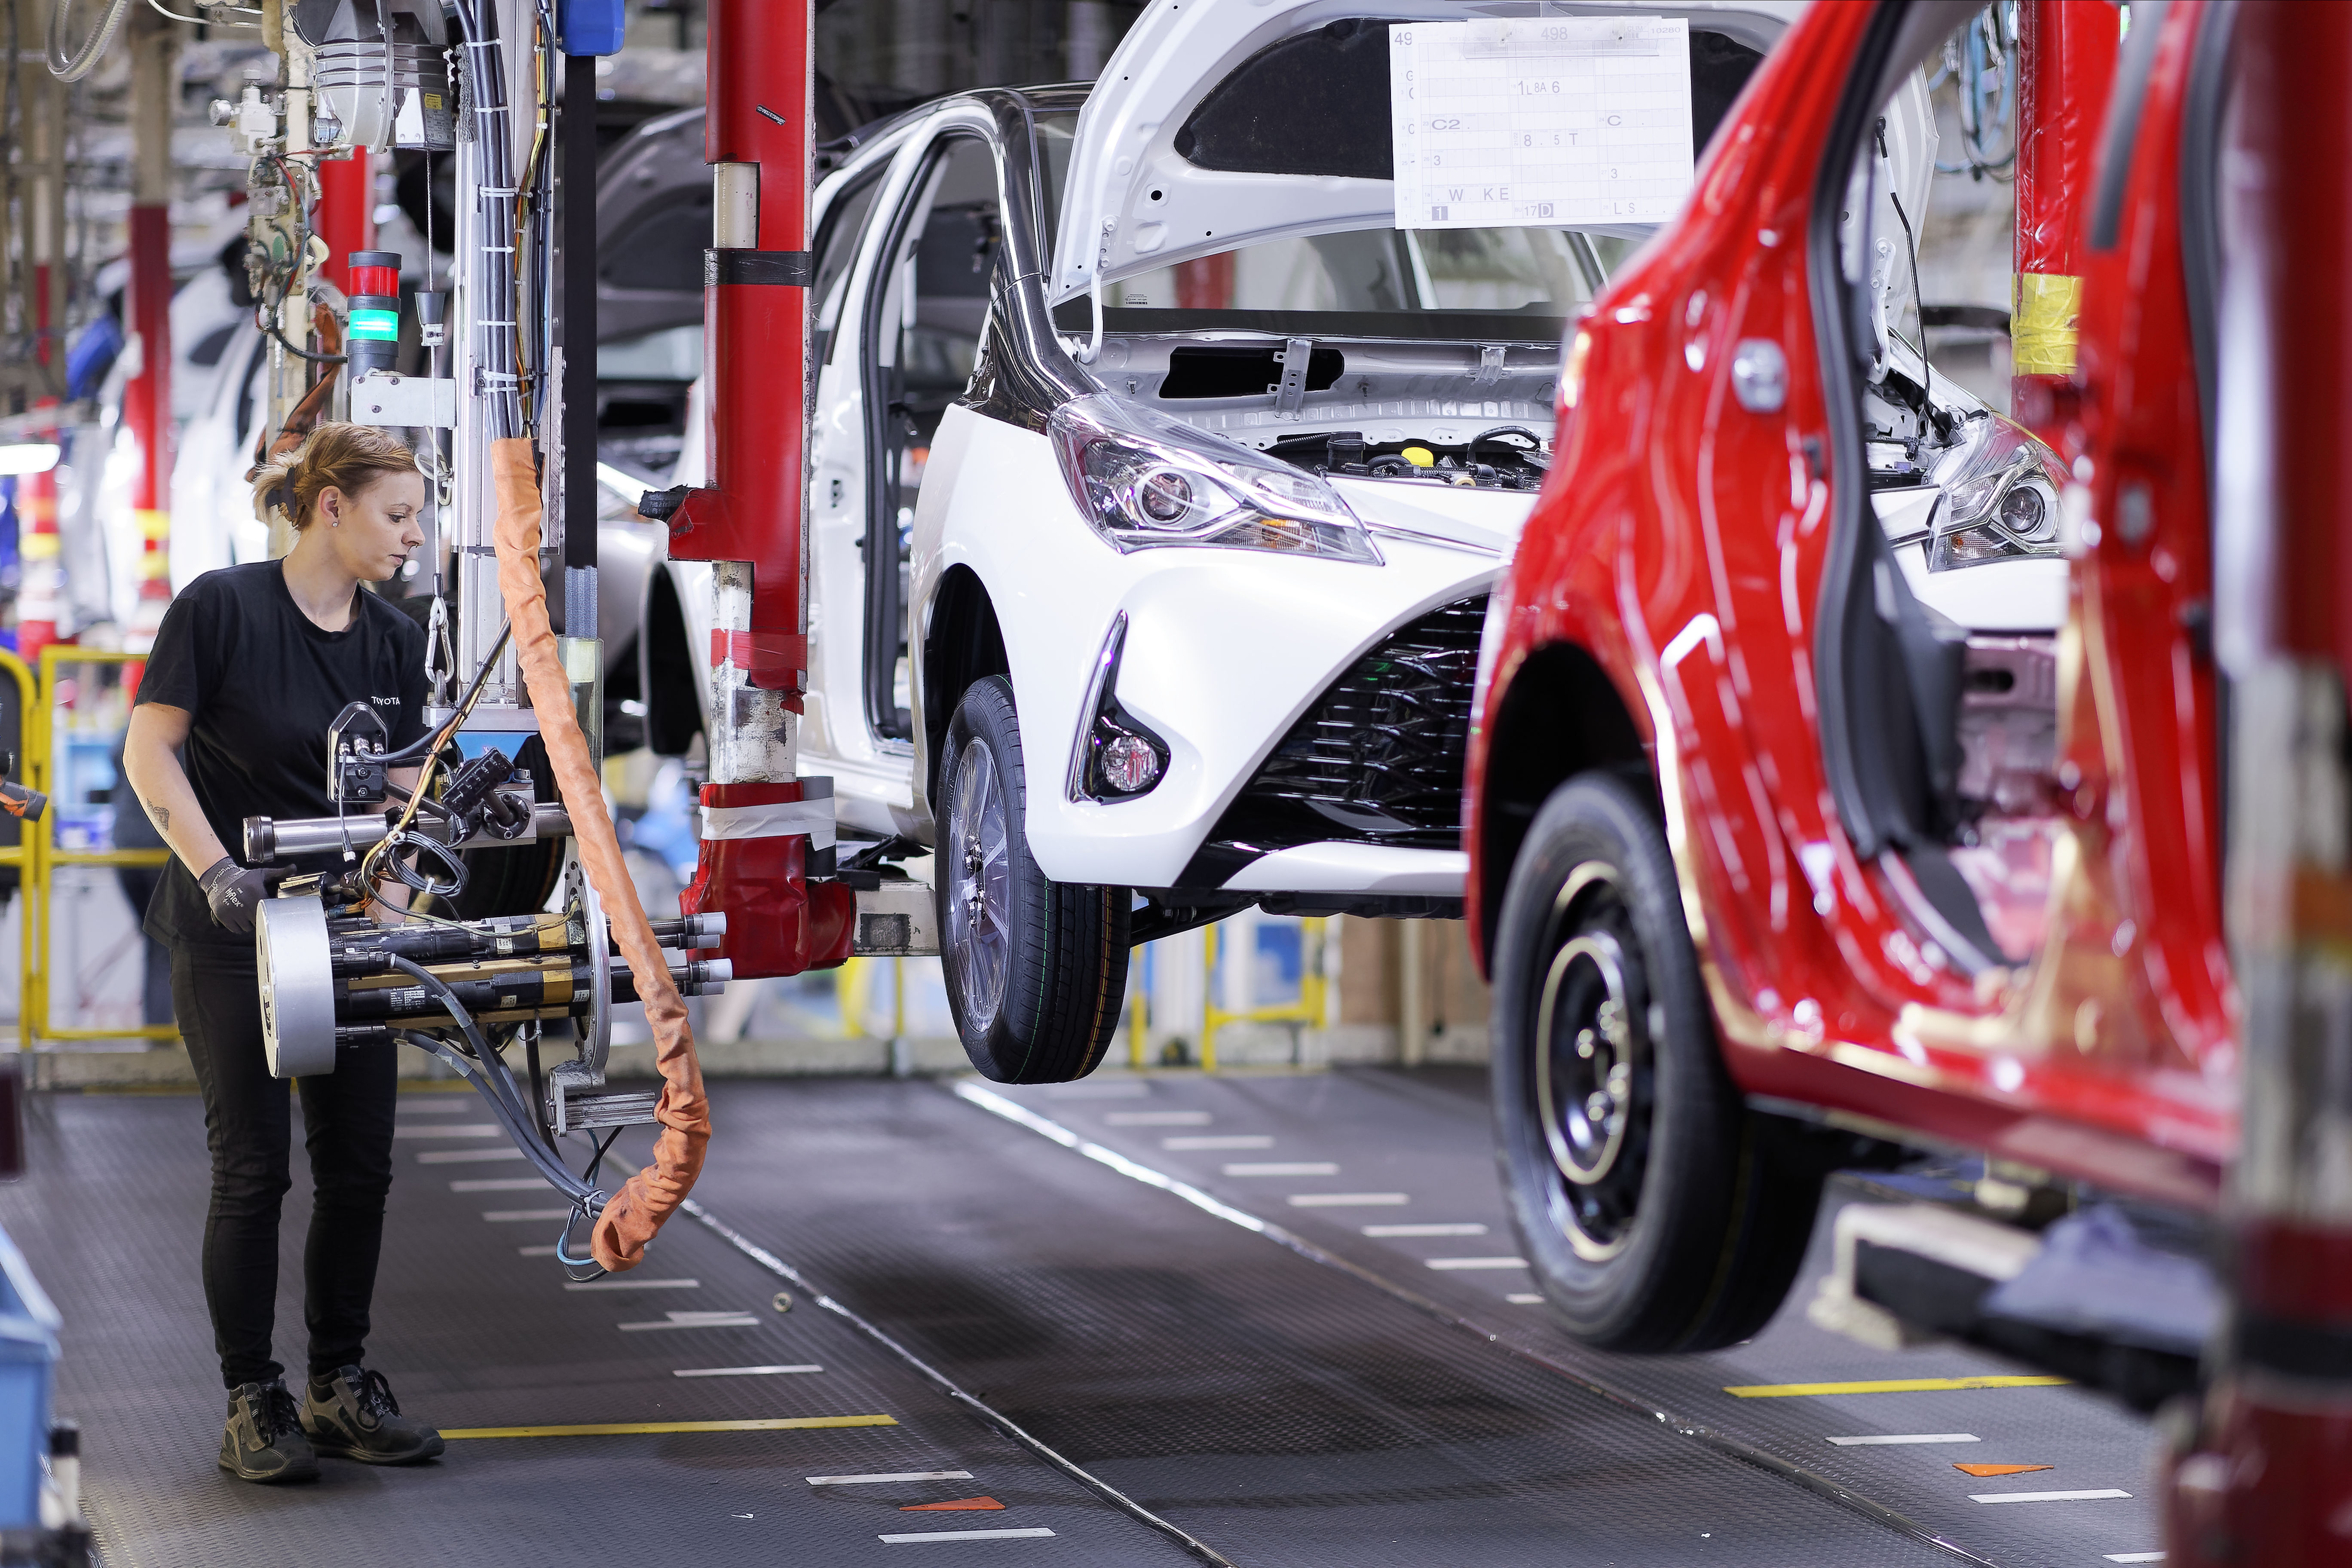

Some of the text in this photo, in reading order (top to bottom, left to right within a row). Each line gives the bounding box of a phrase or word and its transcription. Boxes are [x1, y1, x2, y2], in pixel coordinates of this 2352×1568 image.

[1541, 27, 1568, 41] 498
[1552, 81, 1560, 93] 6
[1432, 119, 1460, 130] C2
[1607, 115, 1621, 126] C
[1524, 135, 1531, 147] 8
[1554, 135, 1560, 145] 5
[1569, 133, 1578, 145] T
[1434, 156, 1441, 165] 3
[1611, 168, 1618, 178] 3
[1449, 189, 1464, 201] W
